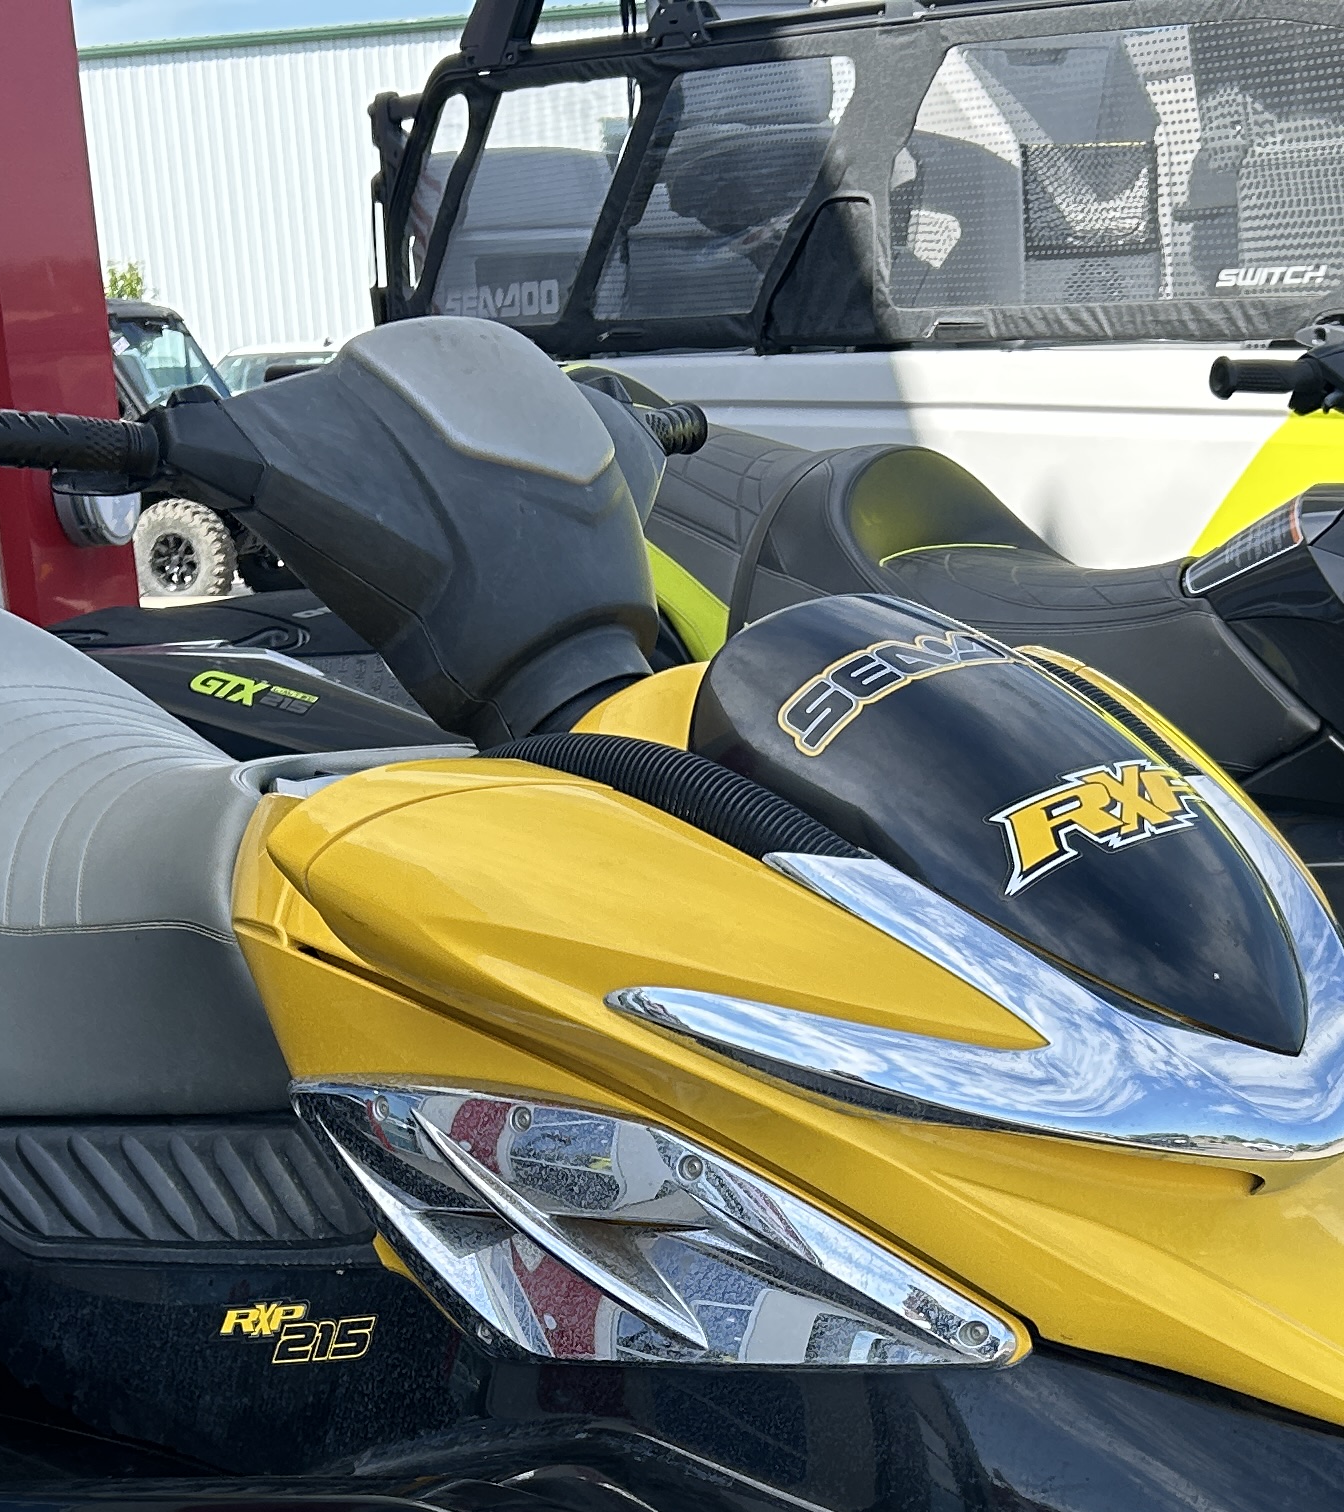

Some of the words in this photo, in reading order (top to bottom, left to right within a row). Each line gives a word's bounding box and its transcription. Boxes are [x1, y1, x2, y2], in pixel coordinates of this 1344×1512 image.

[1216, 264, 1328, 287] SWITCH
[190, 670, 272, 707] GTX
[219, 1301, 307, 1338] RXP
[271, 1315, 377, 1365] 215
